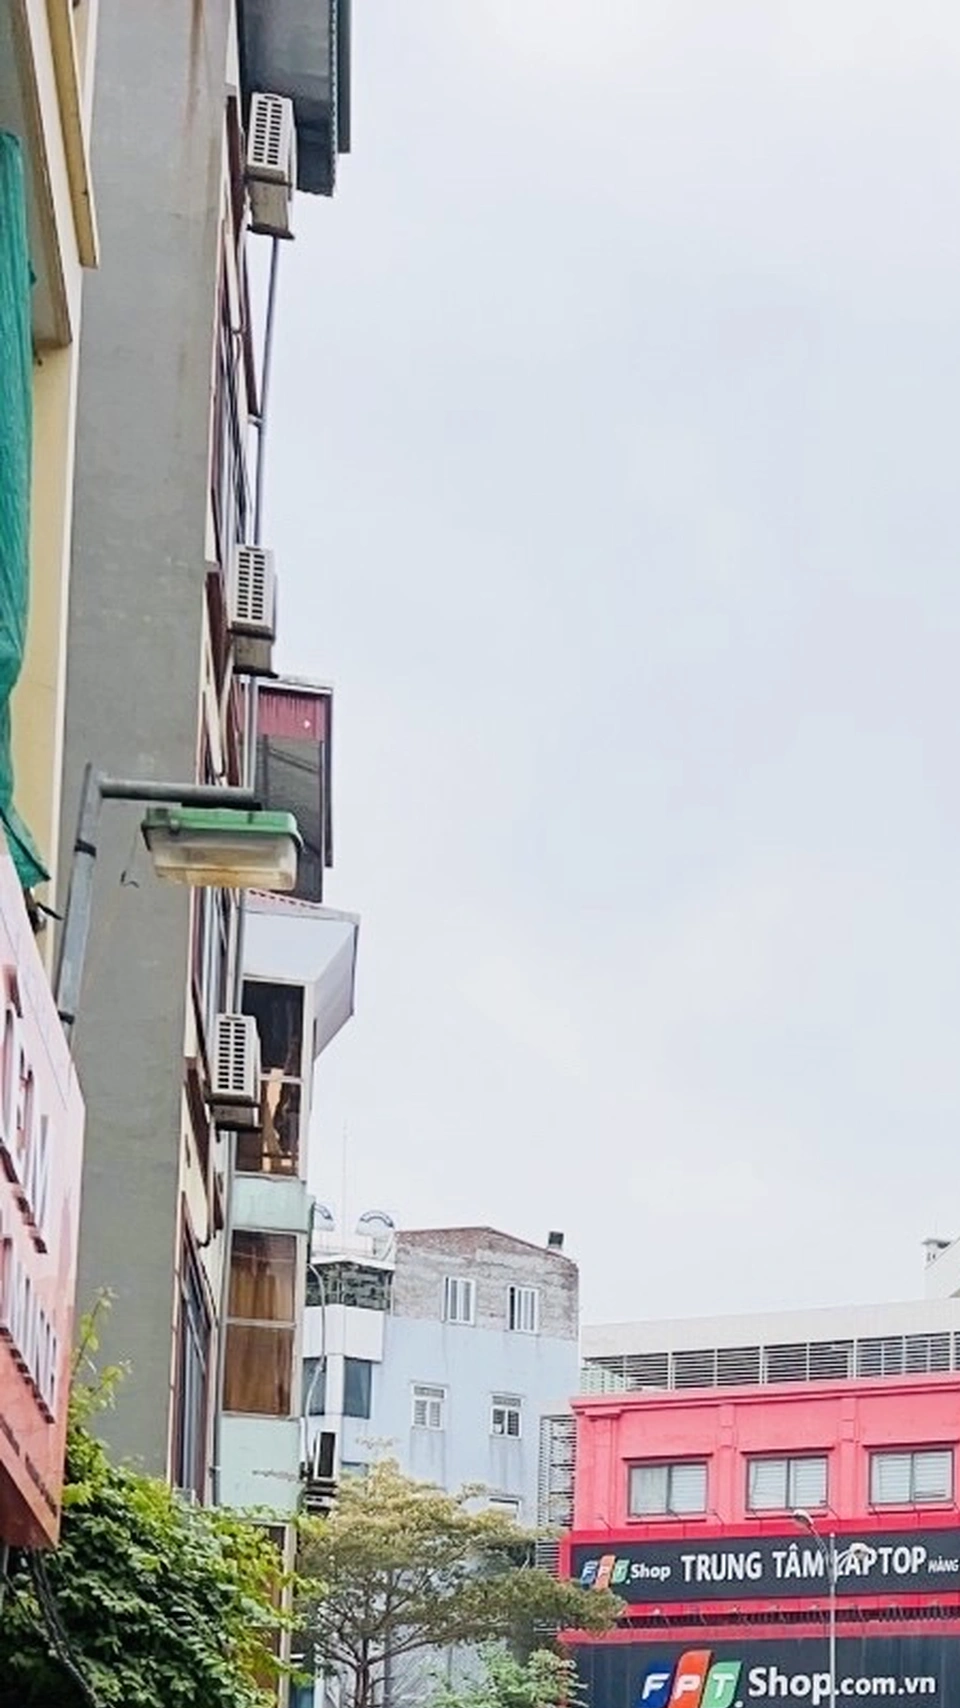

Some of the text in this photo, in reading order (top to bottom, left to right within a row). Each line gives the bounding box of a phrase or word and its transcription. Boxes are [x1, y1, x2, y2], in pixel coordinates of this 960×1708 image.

[631, 1563, 671, 1582] Shop
[681, 1552, 762, 1582] TRUNG
[772, 1543, 824, 1577] TÂM
[833, 1546, 927, 1576] LAPTOP
